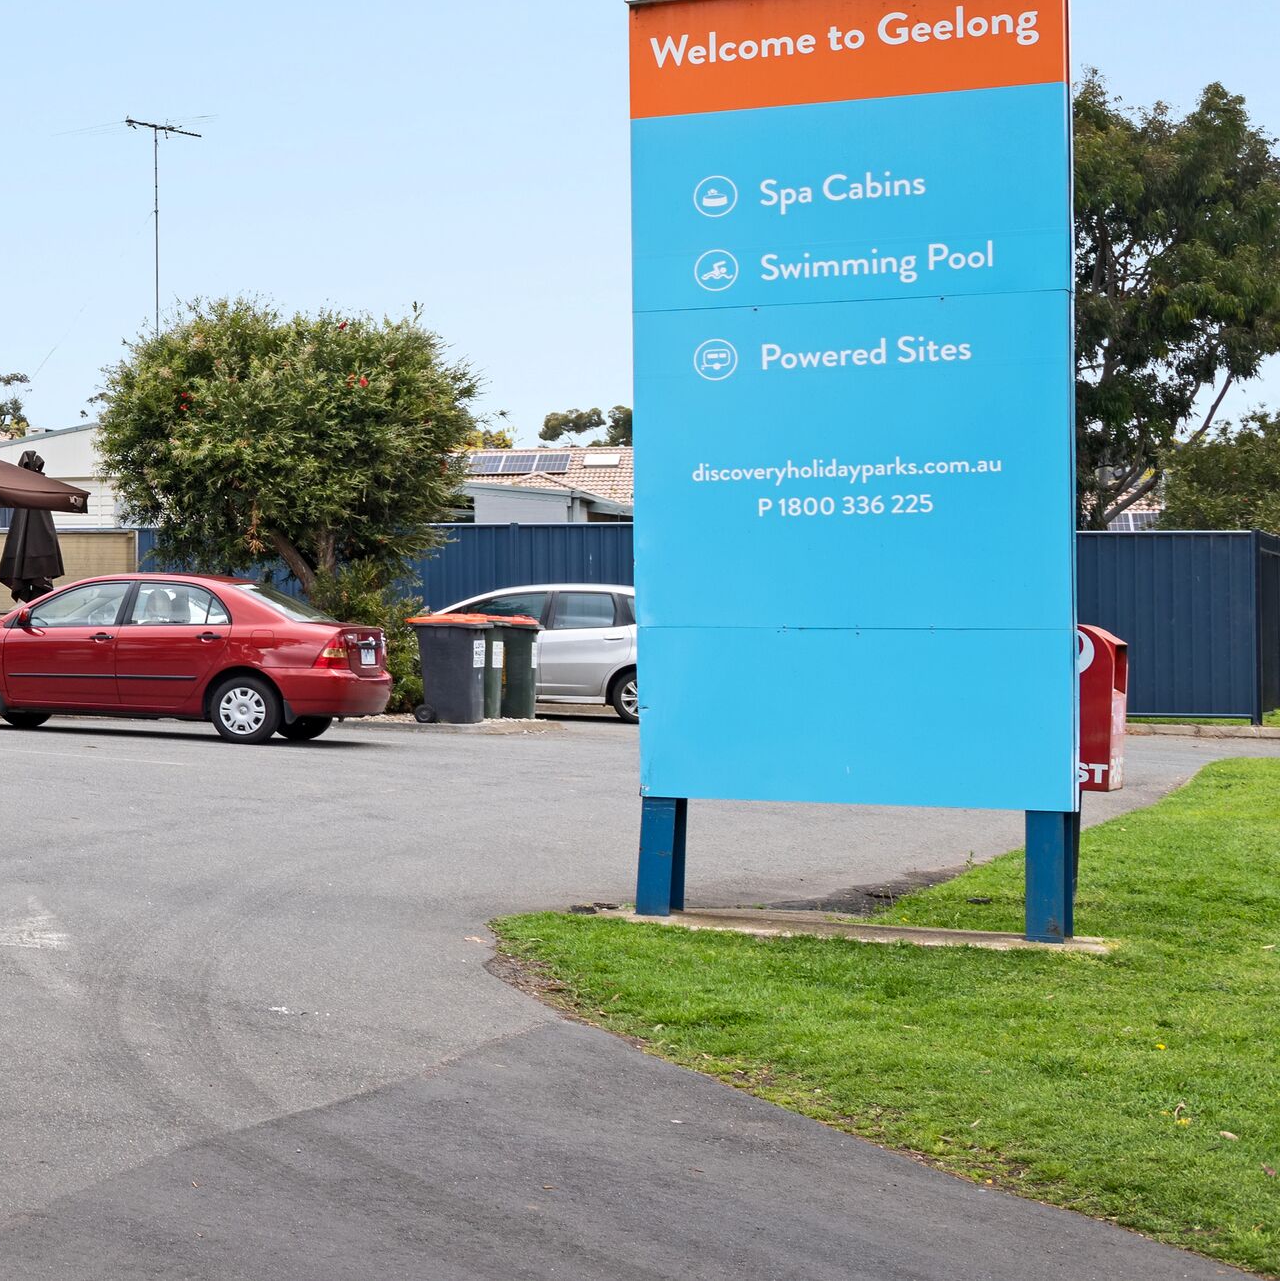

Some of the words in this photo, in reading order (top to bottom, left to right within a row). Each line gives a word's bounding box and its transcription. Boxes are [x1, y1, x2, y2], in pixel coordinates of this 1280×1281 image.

[650, 31, 816, 69] Welcome
[827, 25, 865, 52] to
[877, 5, 1040, 45] Geelong
[760, 179, 812, 215] Spa
[822, 171, 926, 201] Cabins
[760, 248, 918, 283] Swimming
[928, 240, 993, 271] Pool
[761, 337, 887, 370] Powered
[897, 335, 972, 364] Sites
[692, 456, 1002, 486] discoveryholidayparks.com.au
[758, 498, 772, 517] P
[778, 496, 835, 516] 1800
[842, 495, 885, 515] 336
[891, 494, 934, 514] 225
[1079, 762, 1108, 784] ST
